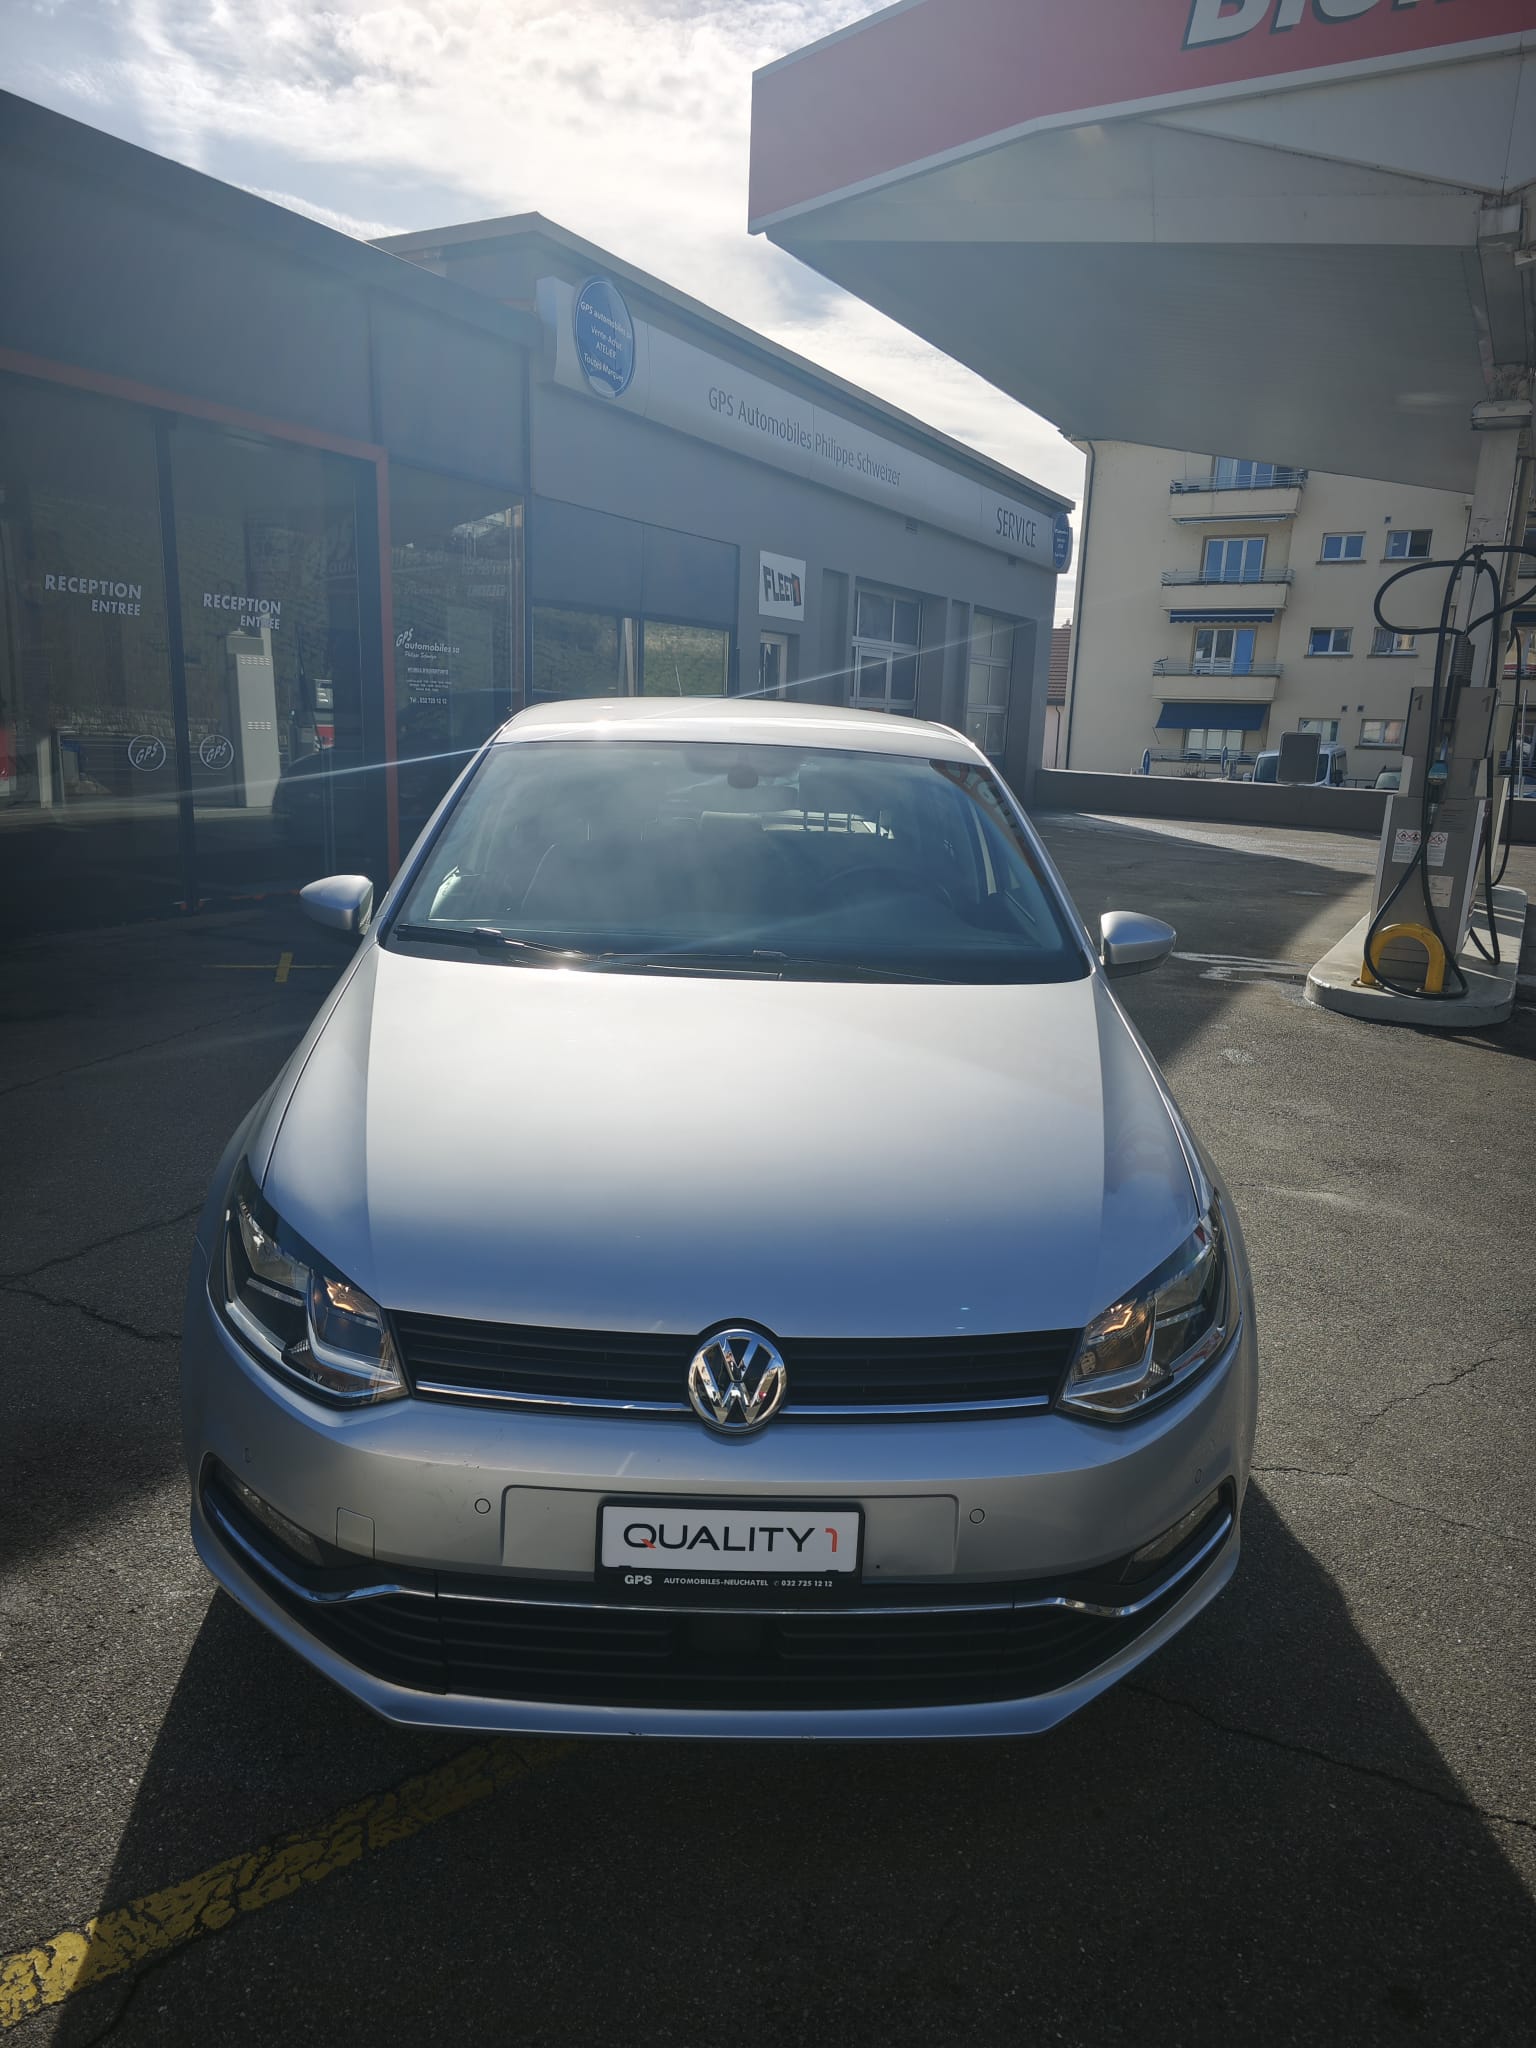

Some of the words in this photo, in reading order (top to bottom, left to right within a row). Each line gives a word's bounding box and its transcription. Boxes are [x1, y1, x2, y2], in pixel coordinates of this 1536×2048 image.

[708, 386, 735, 417] GPS
[738, 400, 812, 450] Automobiles
[814, 432, 855, 468] Philippe
[856, 451, 901, 487] Schweizer
[995, 508, 1037, 548] SERVICE
[44, 574, 142, 600] RECEPTION
[91, 599, 142, 616] ENTREE
[203, 592, 282, 615] RECEPTION
[240, 615, 281, 630] ENTREE
[395, 628, 414, 647] GPS
[404, 642, 452, 654] automobiles
[1414, 694, 1424, 710] 1
[1481, 695, 1492, 712] 1
[136, 741, 159, 765] GPS
[206, 741, 227, 764] GPS
[623, 1523, 816, 1553] QUALITY
[824, 1527, 839, 1553] 1
[624, 1575, 653, 1586] GPS
[663, 1577, 769, 1586] AUTOMOBILES-NEUCHATEL
[781, 1579, 796, 1588] 032
[798, 1579, 812, 1588] 725
[814, 1580, 823, 1588] 12
[824, 1580, 833, 1588] 12
